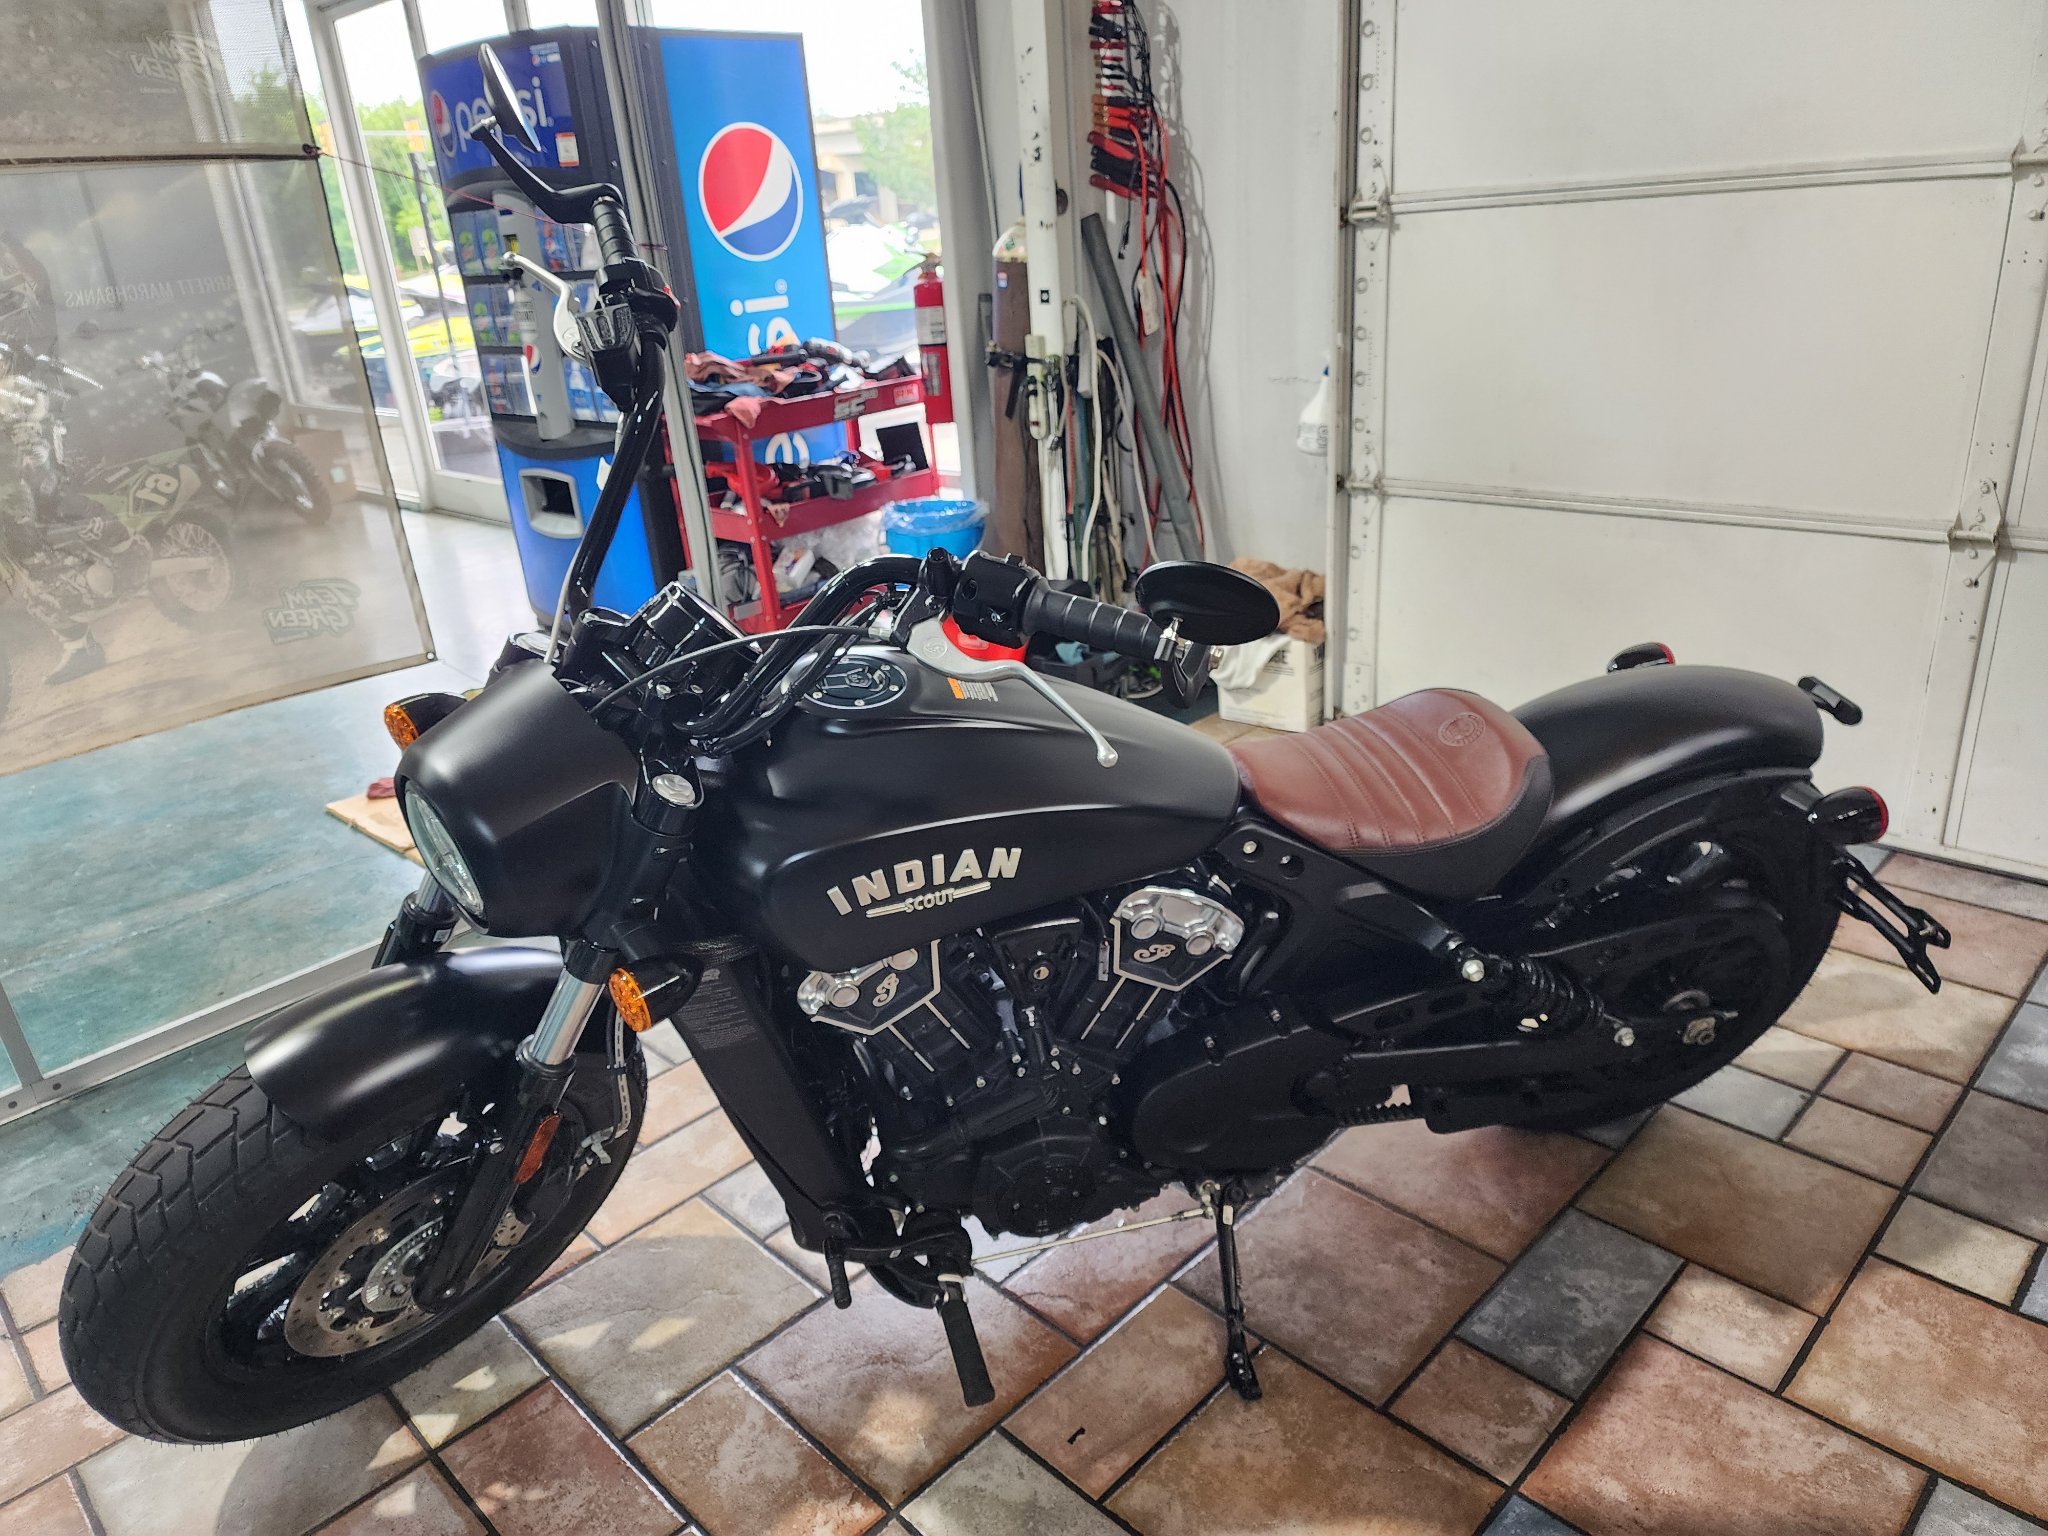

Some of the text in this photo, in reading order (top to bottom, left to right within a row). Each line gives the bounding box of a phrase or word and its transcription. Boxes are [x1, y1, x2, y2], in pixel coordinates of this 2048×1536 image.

[455, 76, 547, 152] pesi
[826, 847, 1022, 916] INDIAN
[904, 887, 955, 913] SCOUT
